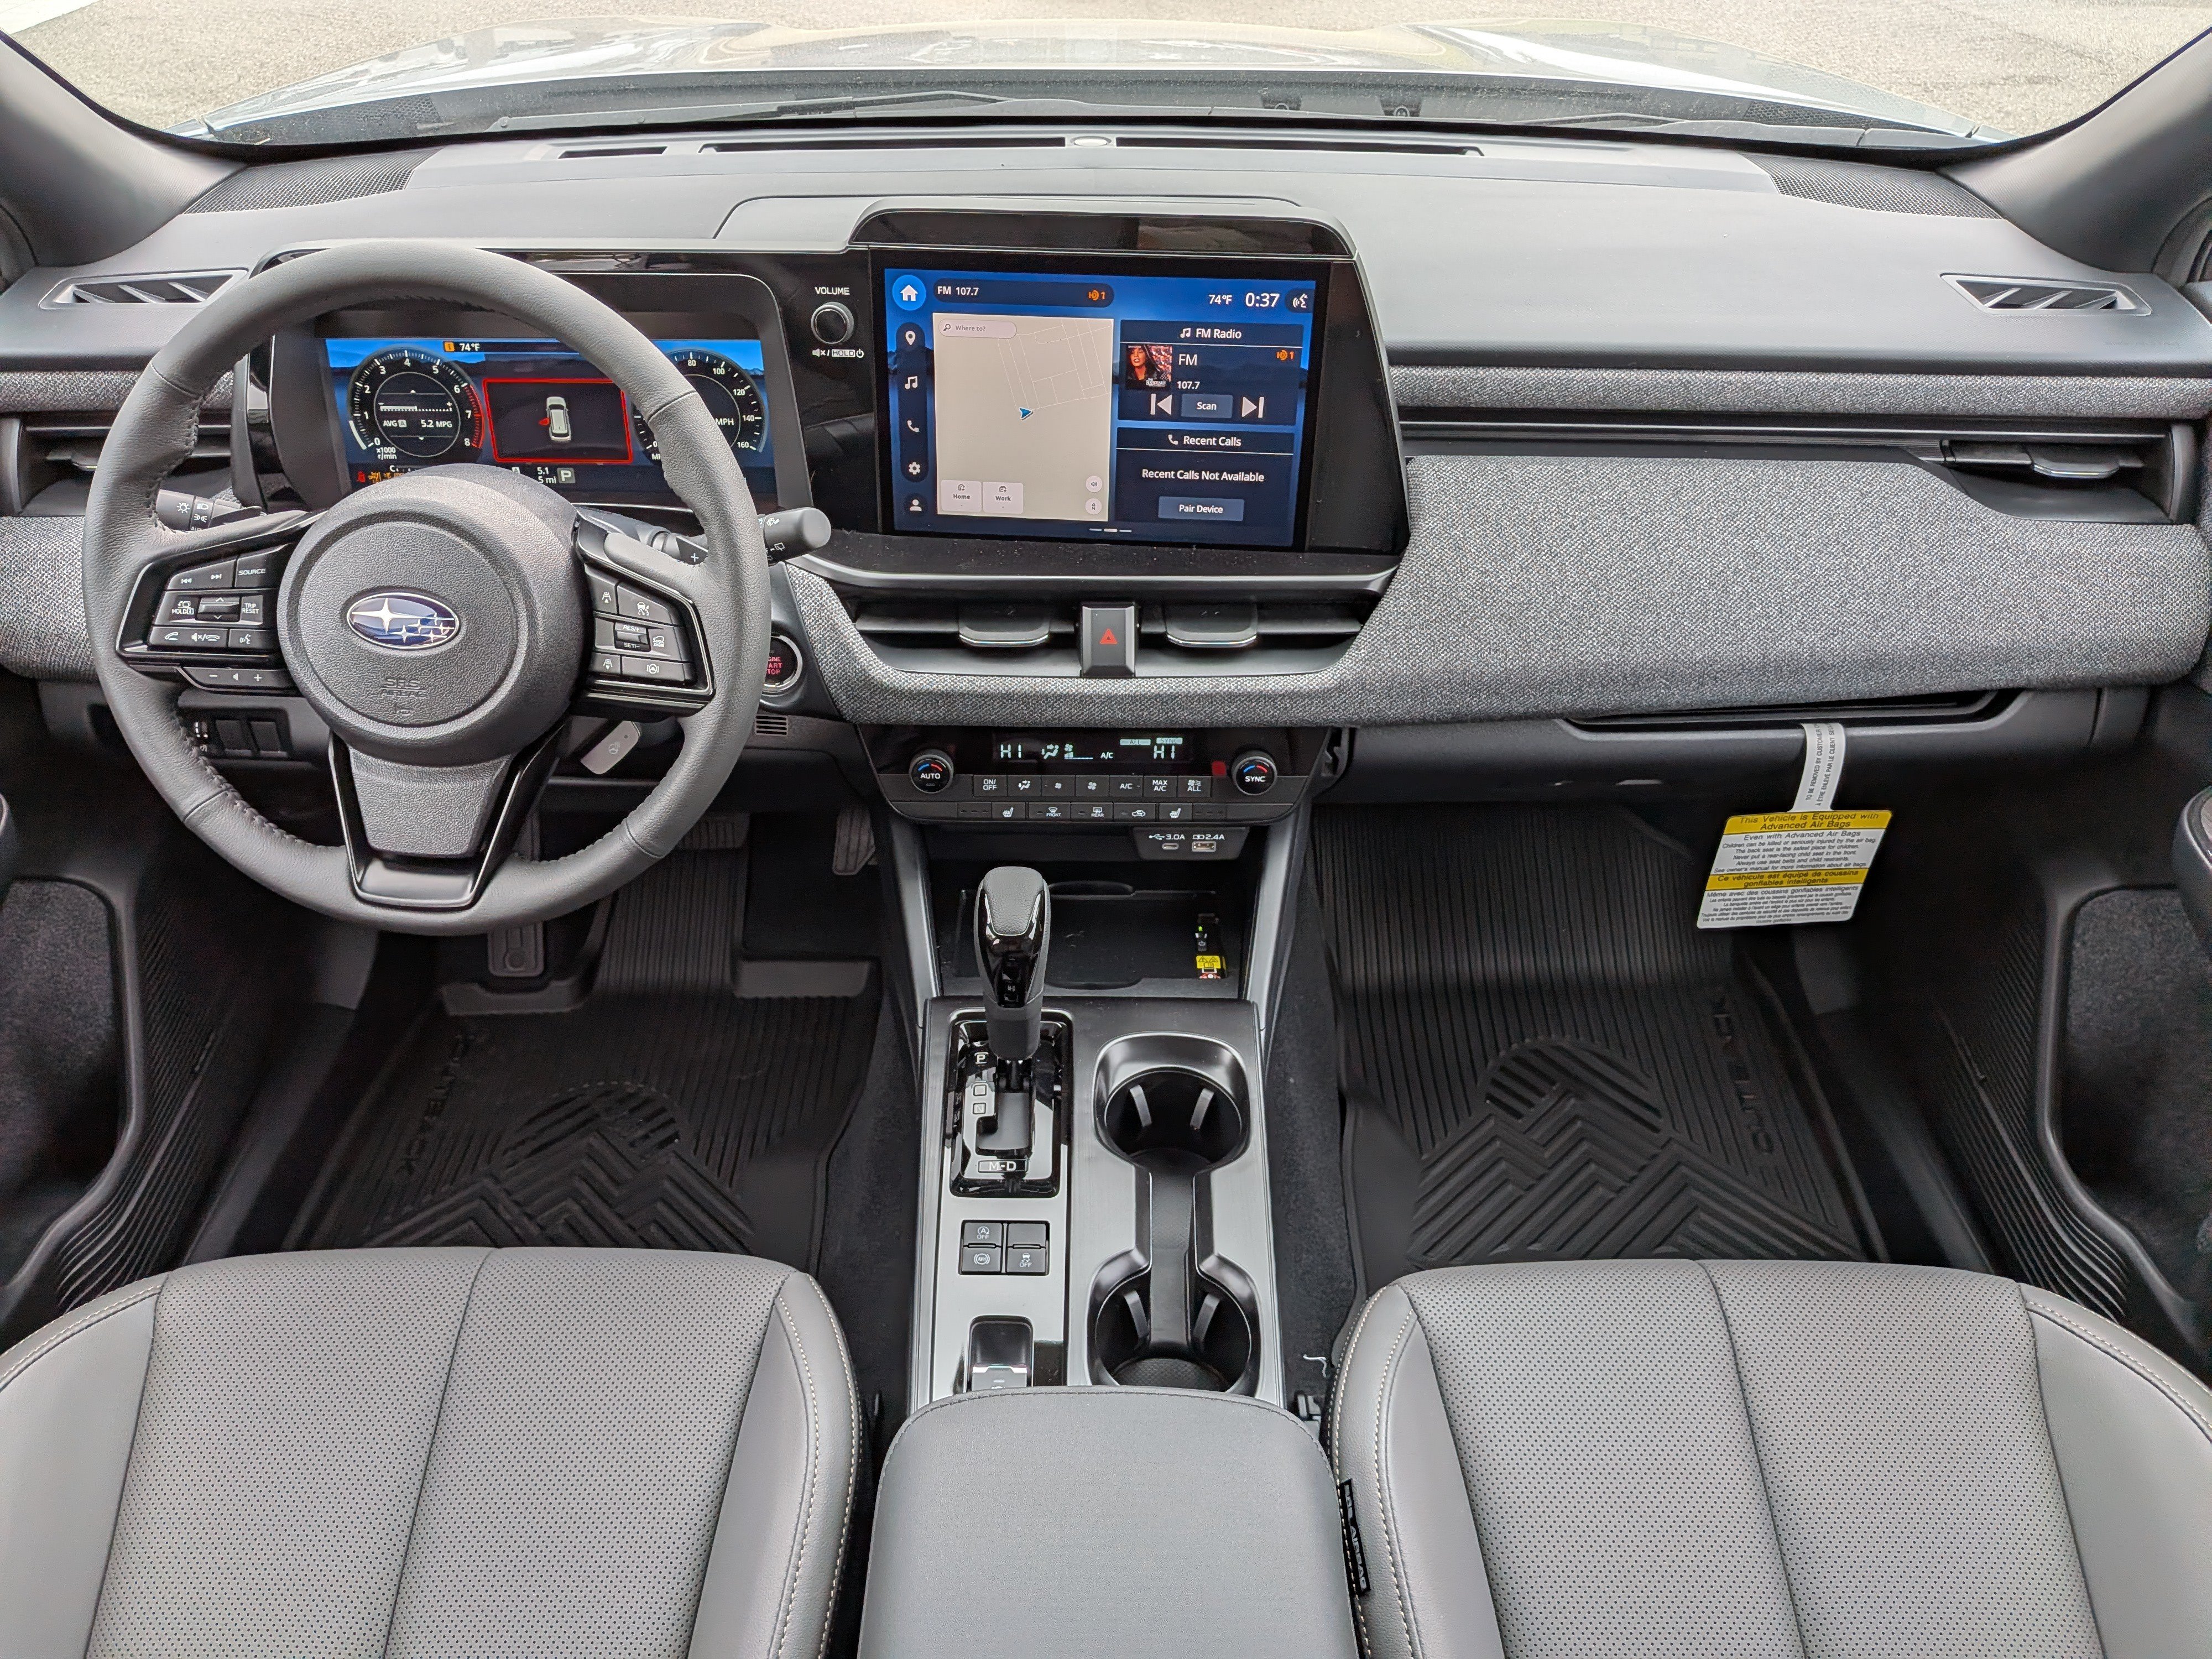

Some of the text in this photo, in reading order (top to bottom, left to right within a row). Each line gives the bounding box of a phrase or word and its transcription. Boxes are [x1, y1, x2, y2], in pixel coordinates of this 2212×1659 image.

[815, 286, 850, 295] VOLUME
[938, 286, 979, 296] FM 107.7
[1208, 294, 1233, 305] 74°F
[1245, 293, 1280, 307] 0:37
[1196, 328, 1241, 339] FM Radio
[459, 343, 481, 352] 74°F
[404, 359, 411, 368] 4
[1178, 354, 1198, 366] FM
[379, 366, 386, 375] 3
[432, 366, 439, 374] 5
[364, 385, 371, 394] 2
[453, 385, 461, 394] 6
[1177, 380, 1200, 390] 107.7
[1197, 401, 1217, 410] Scan
[364, 411, 369, 420] 1
[465, 410, 472, 419] 7
[420, 420, 434, 428] 5.2
[436, 420, 453, 429] MPG
[374, 438, 380, 446] 0
[464, 438, 471, 446] 8
[1183, 436, 1241, 447] Recent Calls
[536, 467, 549, 475] 5.1
[1142, 468, 1265, 482] Recent Calls Not Available
[545, 476, 557, 484] mi
[560, 470, 572, 482] P
[1179, 504, 1223, 514] Pair Device
[1100, 752, 1114, 760] A/C
[1763, 814, 1796, 822] Vehicle
[1812, 813, 1856, 821] Equipped
[1760, 821, 1807, 830] Advanced
[1827, 820, 1851, 829] Bags
[977, 1054, 985, 1063] P
